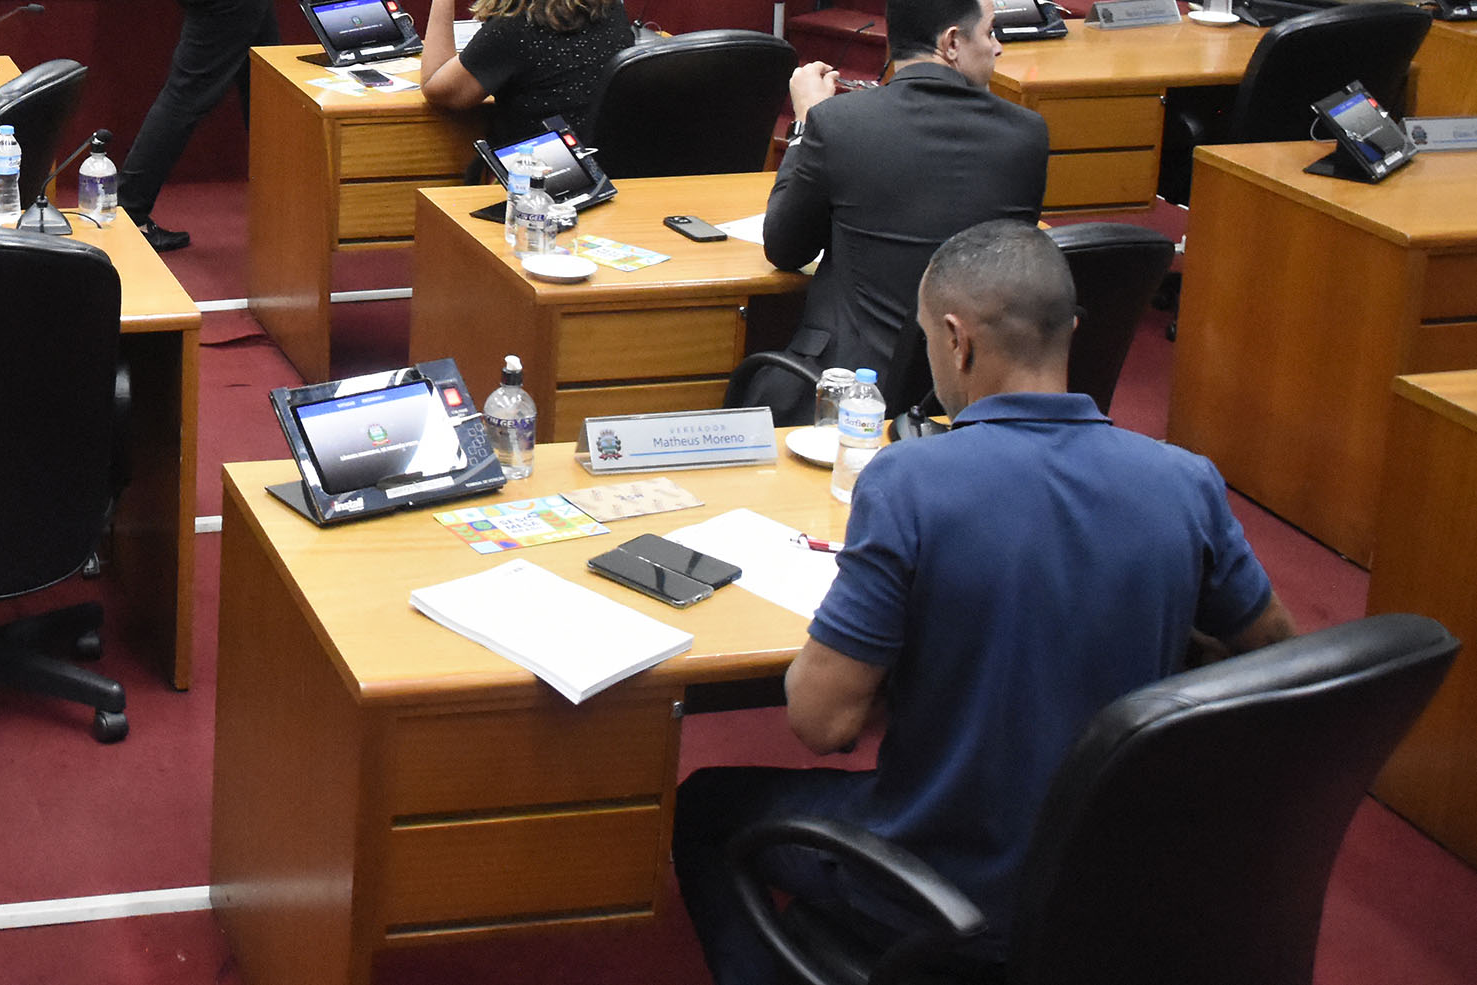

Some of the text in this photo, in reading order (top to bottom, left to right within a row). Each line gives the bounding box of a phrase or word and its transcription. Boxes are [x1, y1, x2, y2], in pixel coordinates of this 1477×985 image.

[670, 425, 725, 433] VEREADOR
[653, 434, 745, 448] Matheus Moreno
